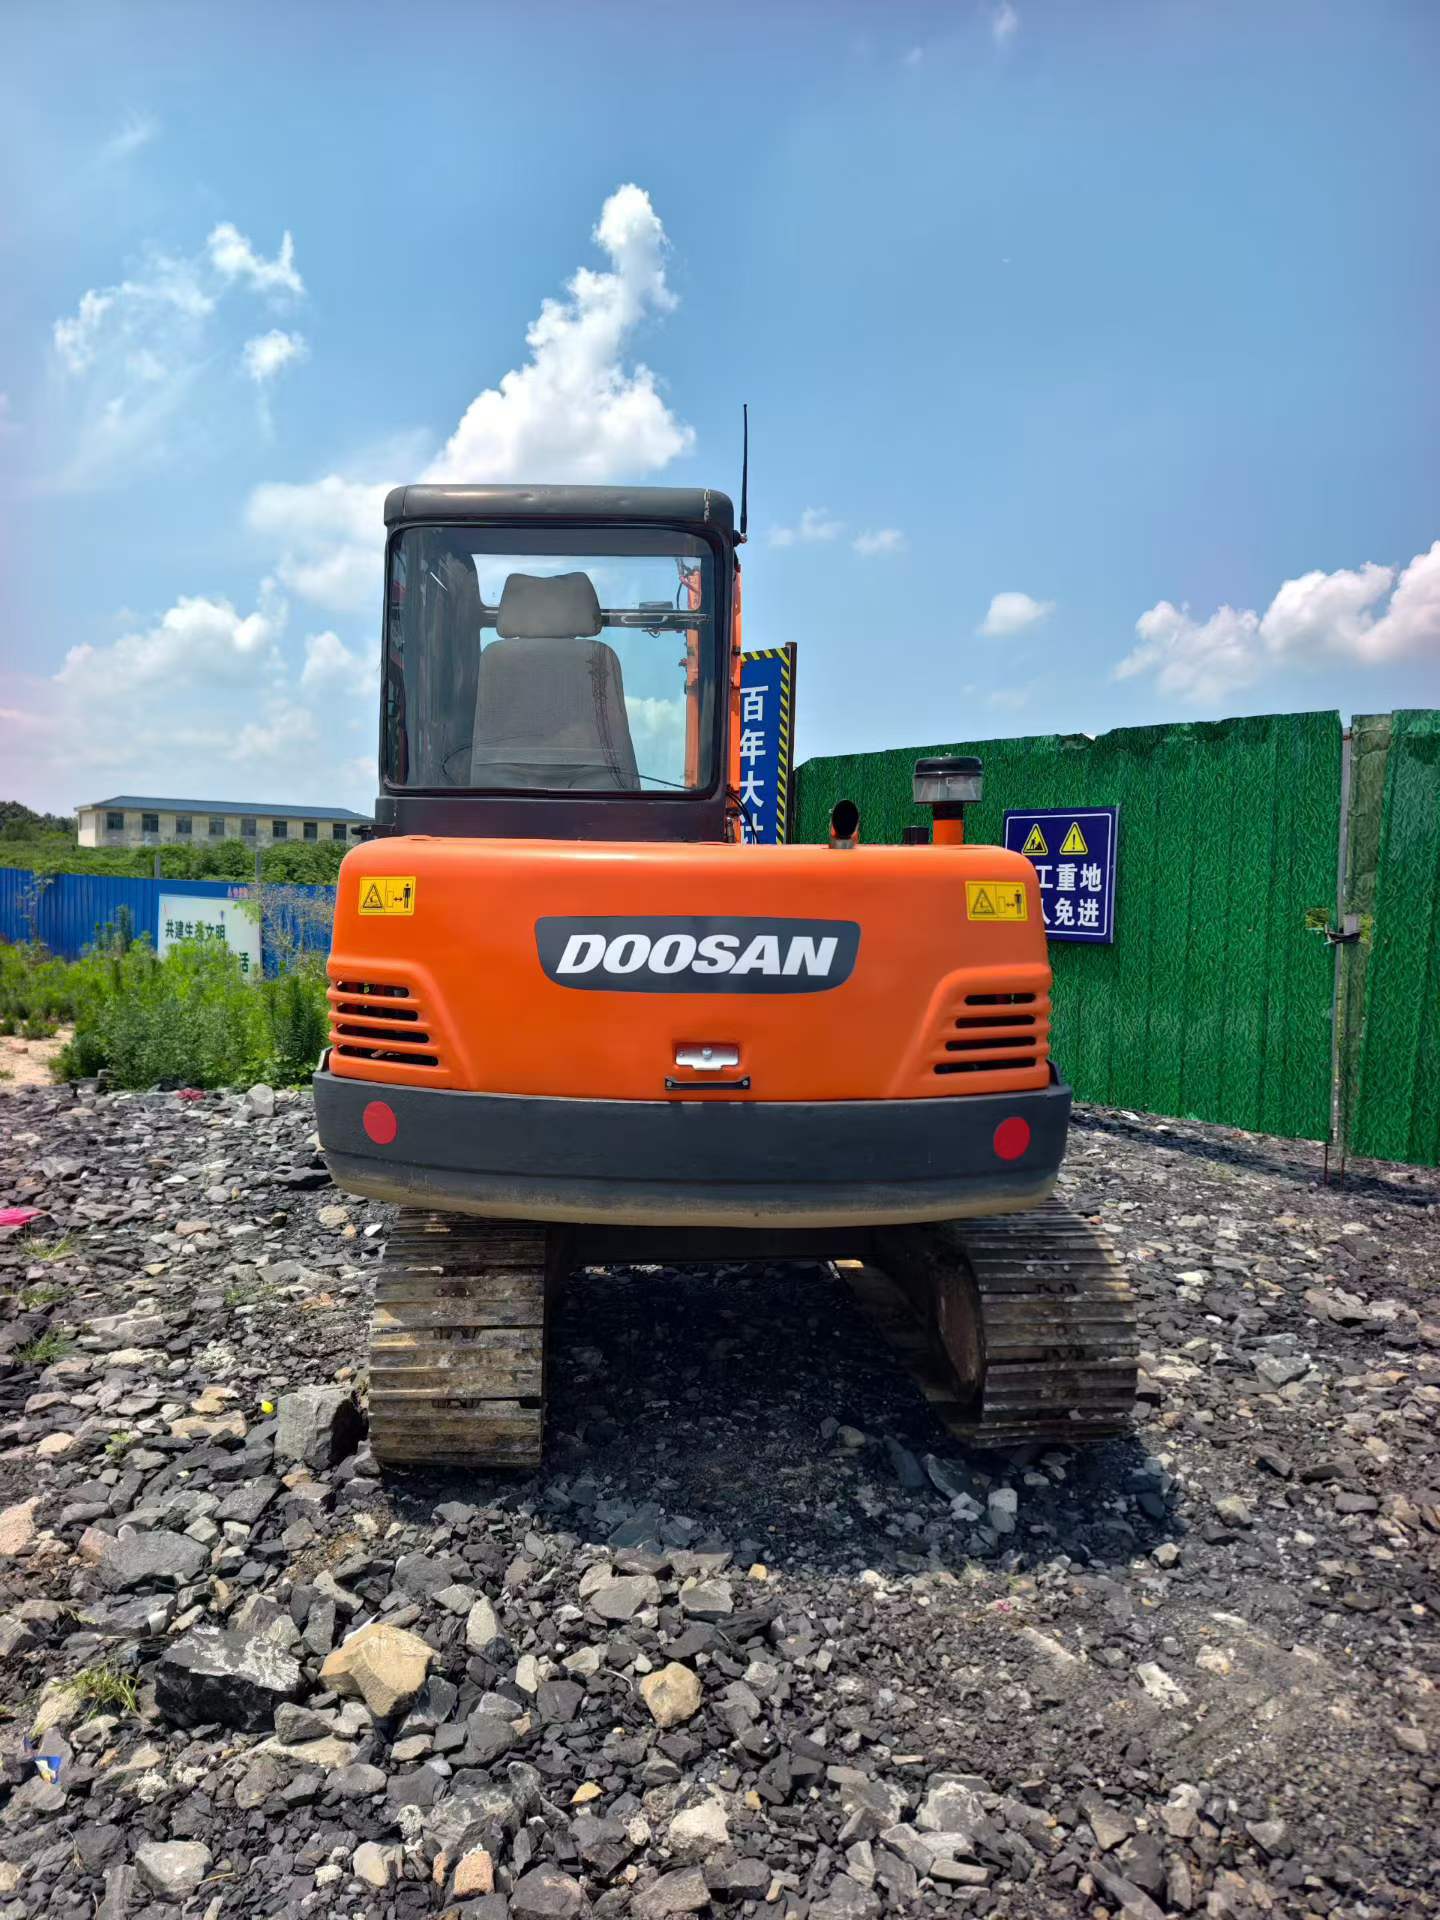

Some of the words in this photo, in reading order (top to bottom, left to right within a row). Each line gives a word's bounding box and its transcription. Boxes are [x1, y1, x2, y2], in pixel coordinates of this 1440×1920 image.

[1035, 862, 1102, 892] 工重地
[556, 934, 838, 976] DOOSAN
